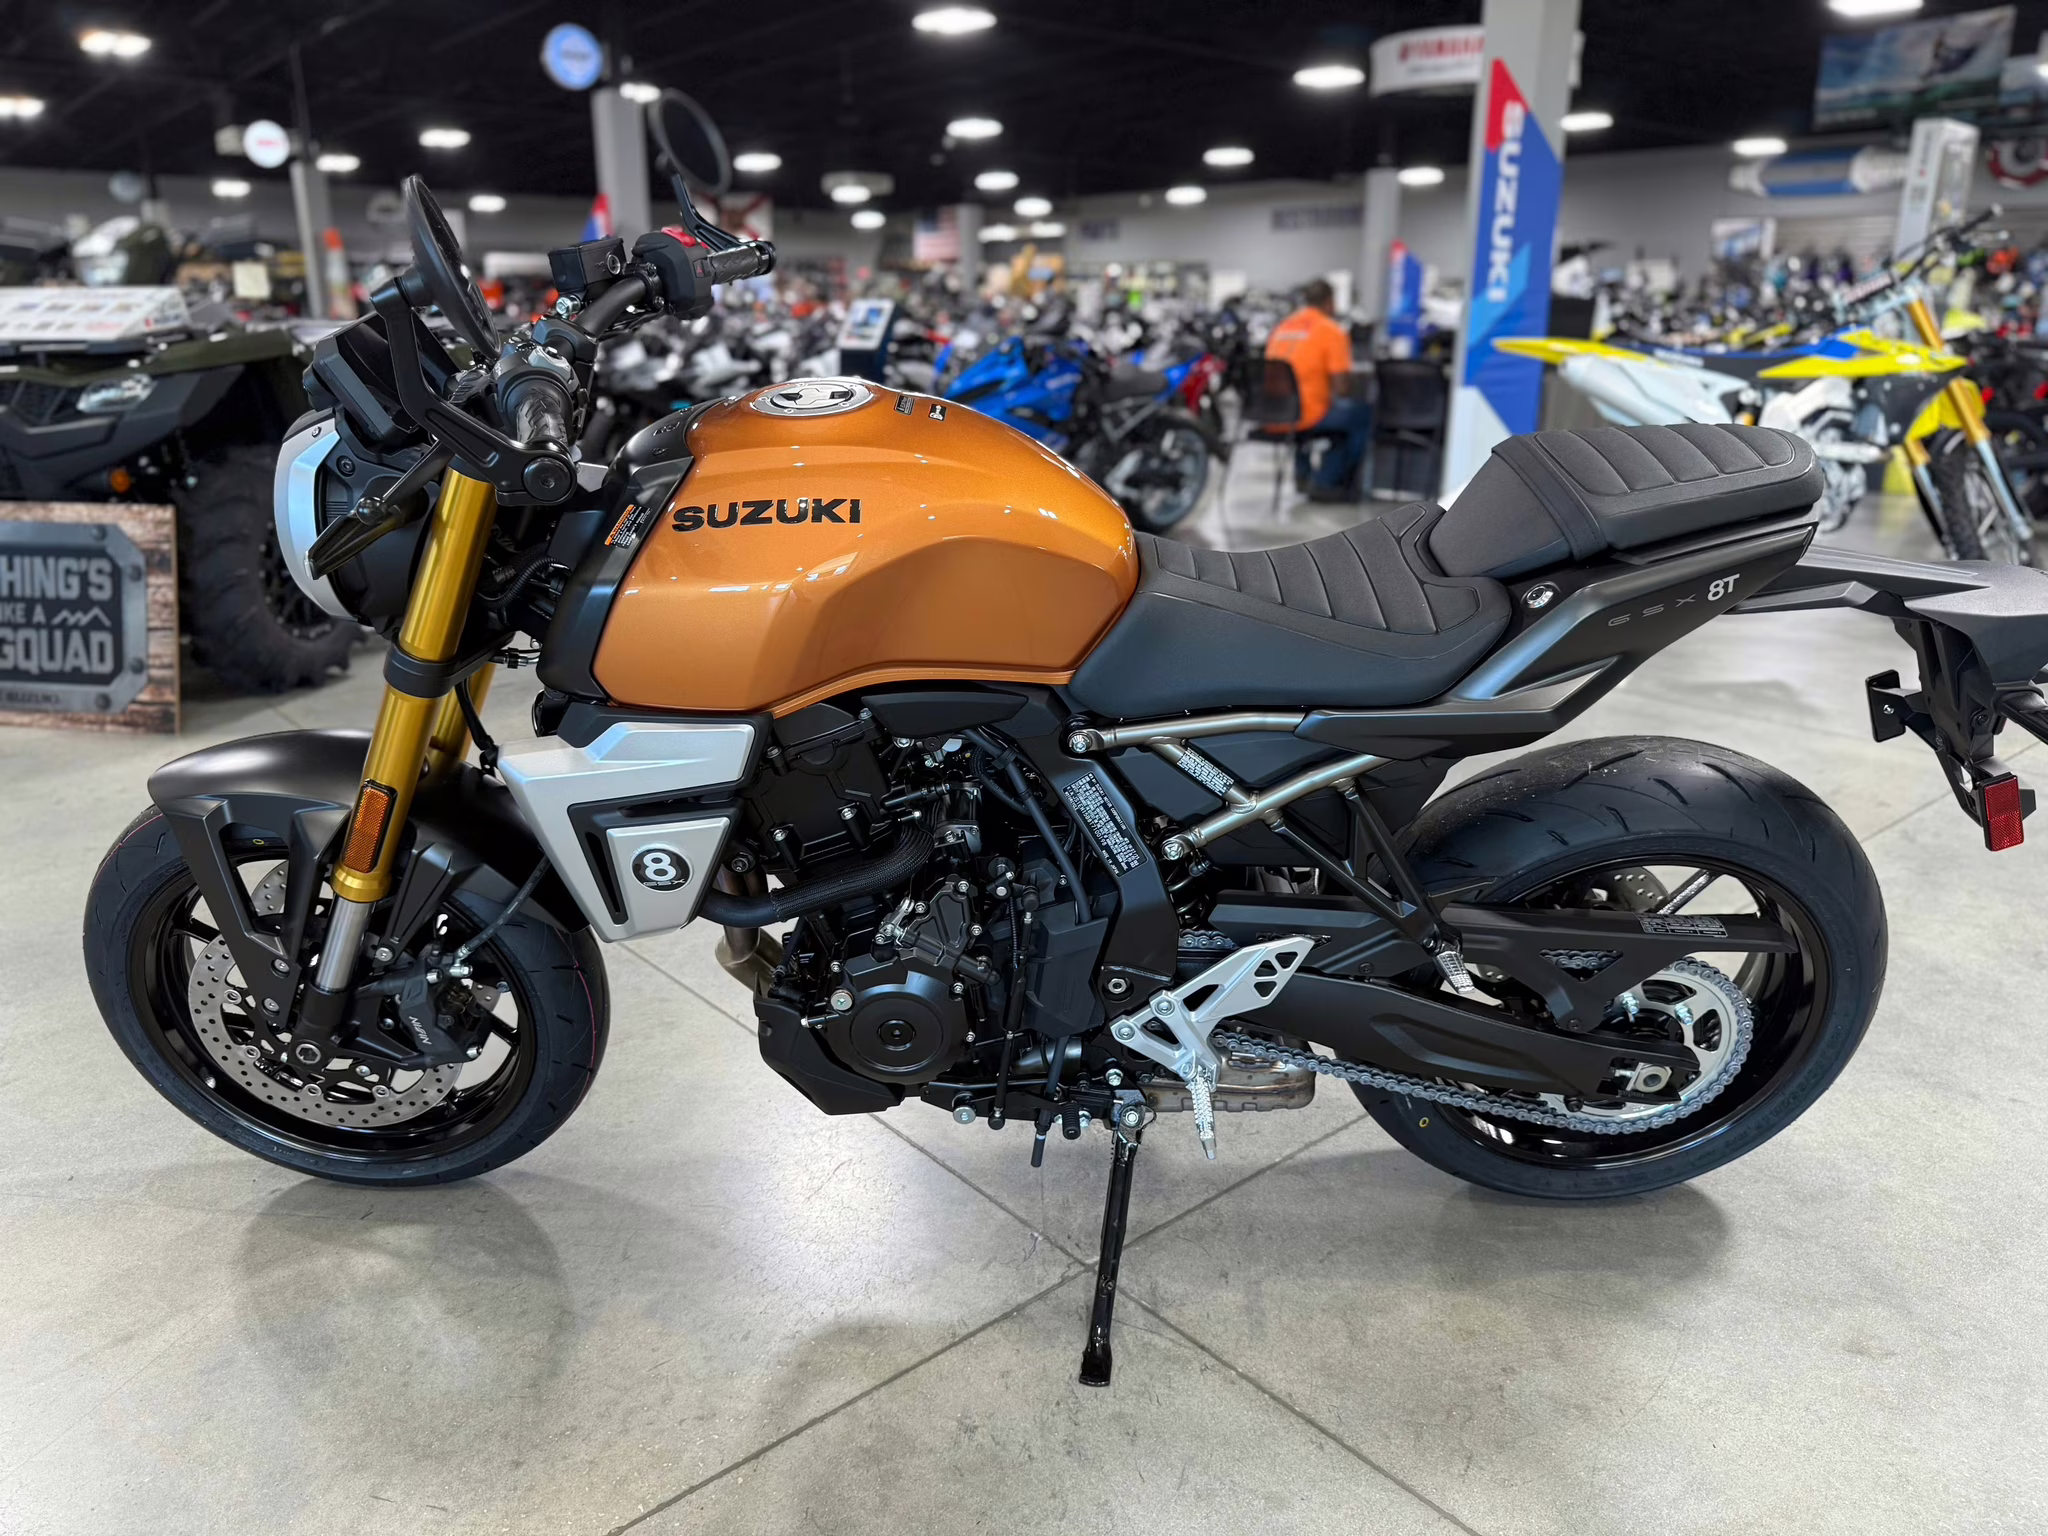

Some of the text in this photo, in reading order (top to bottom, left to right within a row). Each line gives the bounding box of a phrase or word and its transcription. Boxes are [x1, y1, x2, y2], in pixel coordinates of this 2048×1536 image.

[1487, 99, 1526, 303] SUZUKI
[672, 498, 862, 532] SUZUKI
[1707, 573, 1740, 601] 8T
[32, 603, 46, 625] A
[643, 852, 677, 882] 8
[643, 878, 686, 887] GSX
